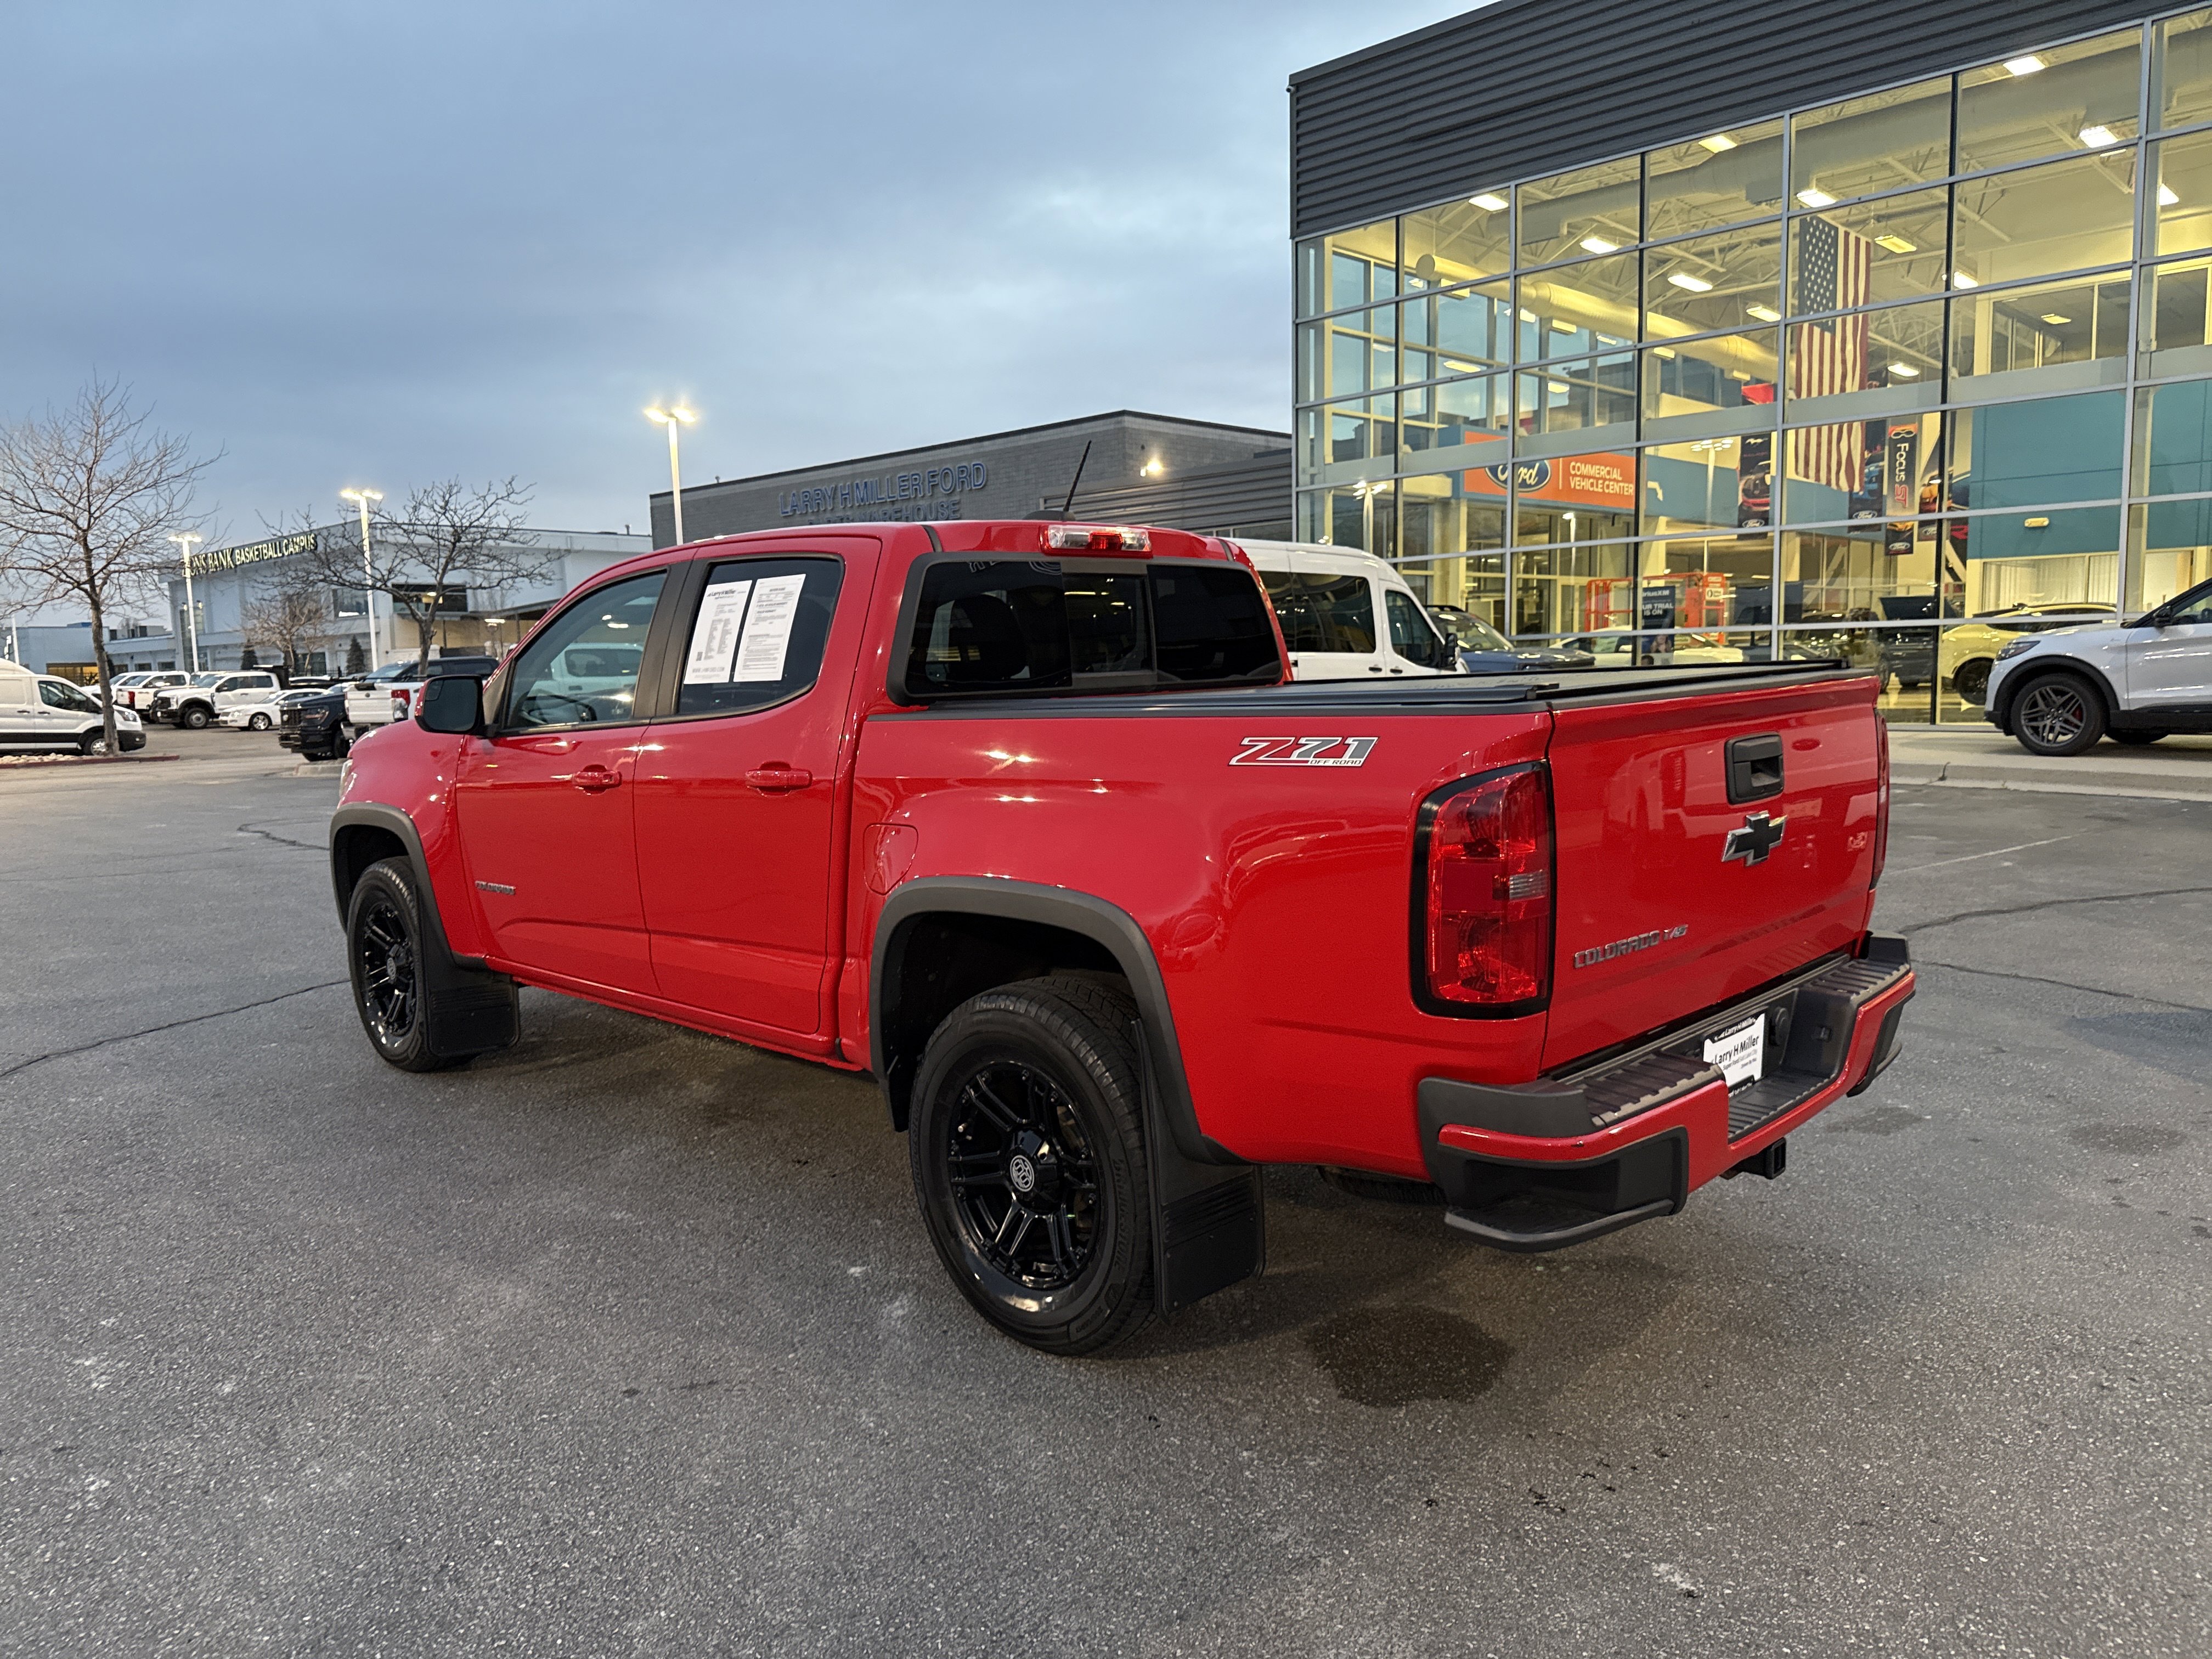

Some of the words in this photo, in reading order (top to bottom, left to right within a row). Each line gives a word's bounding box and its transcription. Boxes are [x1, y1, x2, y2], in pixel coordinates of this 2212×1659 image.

[1570, 461, 1622, 480] COMMERCIAL
[1895, 443, 1909, 482] FOCUS
[779, 484, 836, 517] LARRY
[839, 483, 852, 508] H
[854, 472, 923, 506] MILLER
[926, 462, 988, 495] FORD
[1570, 476, 1604, 493] VEHICLE
[1604, 481, 1634, 496] CENTER
[1894, 483, 1909, 509] ST
[207, 548, 235, 573] BANK
[235, 540, 283, 566] BASKETBALL
[283, 533, 317, 556] CAMPUS
[1229, 737, 1379, 767] Z71
[1573, 930, 1660, 969] COLORADO
[1714, 1049, 1733, 1064] Larry
[1733, 1043, 1739, 1057] H
[1739, 1035, 1759, 1054] Miller
